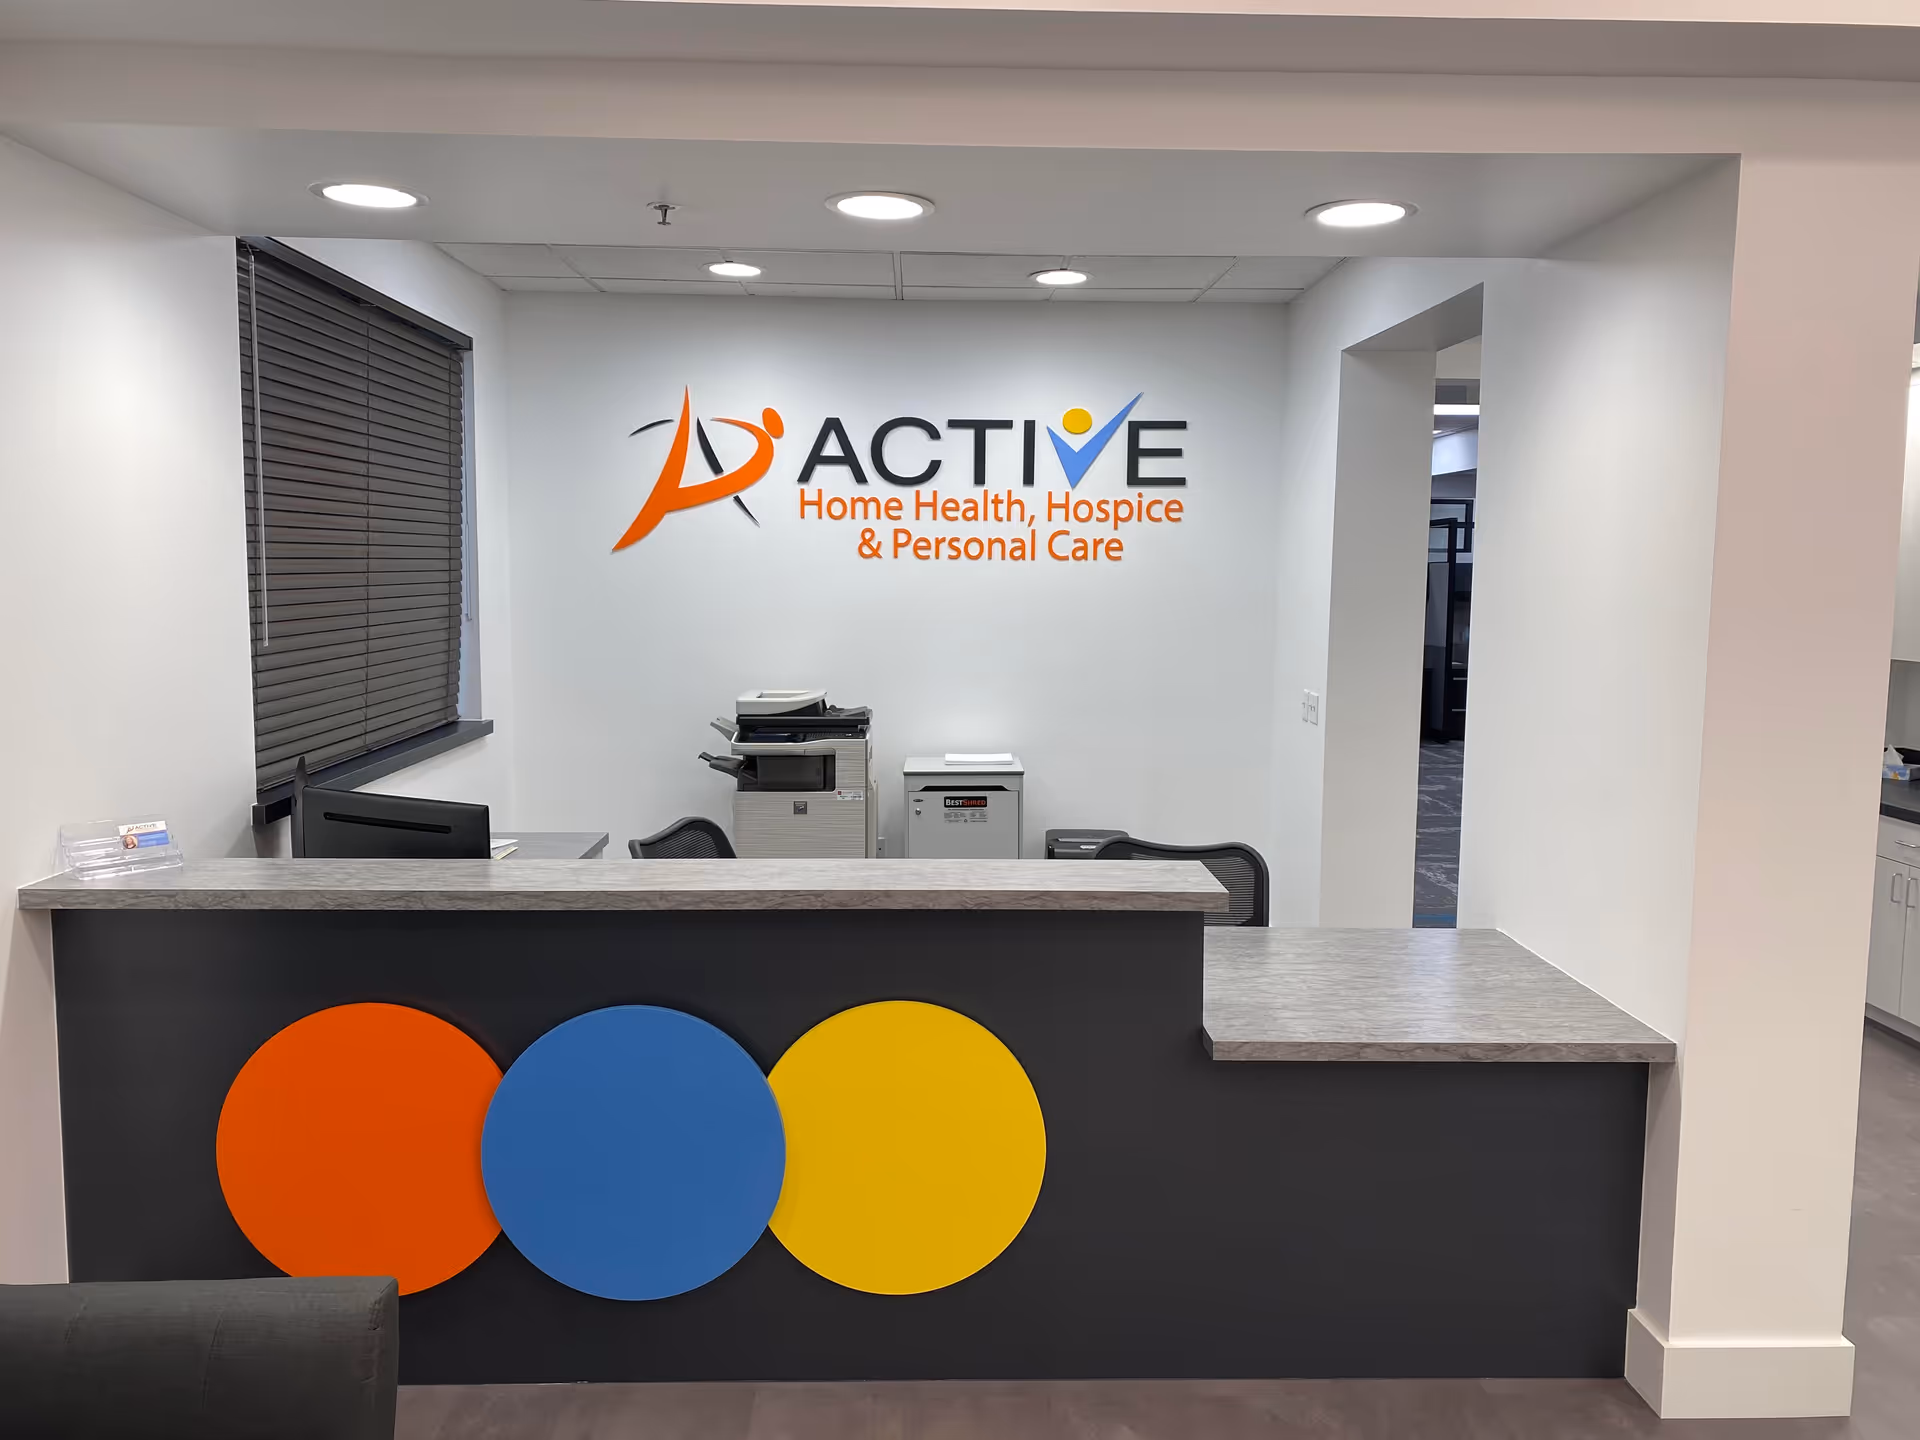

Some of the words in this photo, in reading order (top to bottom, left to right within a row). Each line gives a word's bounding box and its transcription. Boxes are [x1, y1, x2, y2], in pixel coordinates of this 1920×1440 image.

[797, 392, 1187, 489] ACTIVE
[799, 489, 903, 521] Home
[914, 489, 1035, 528] Health,
[1047, 491, 1184, 530] Hospice
[857, 529, 883, 560] &
[894, 529, 1036, 561] Personal
[1047, 530, 1124, 560] Care
